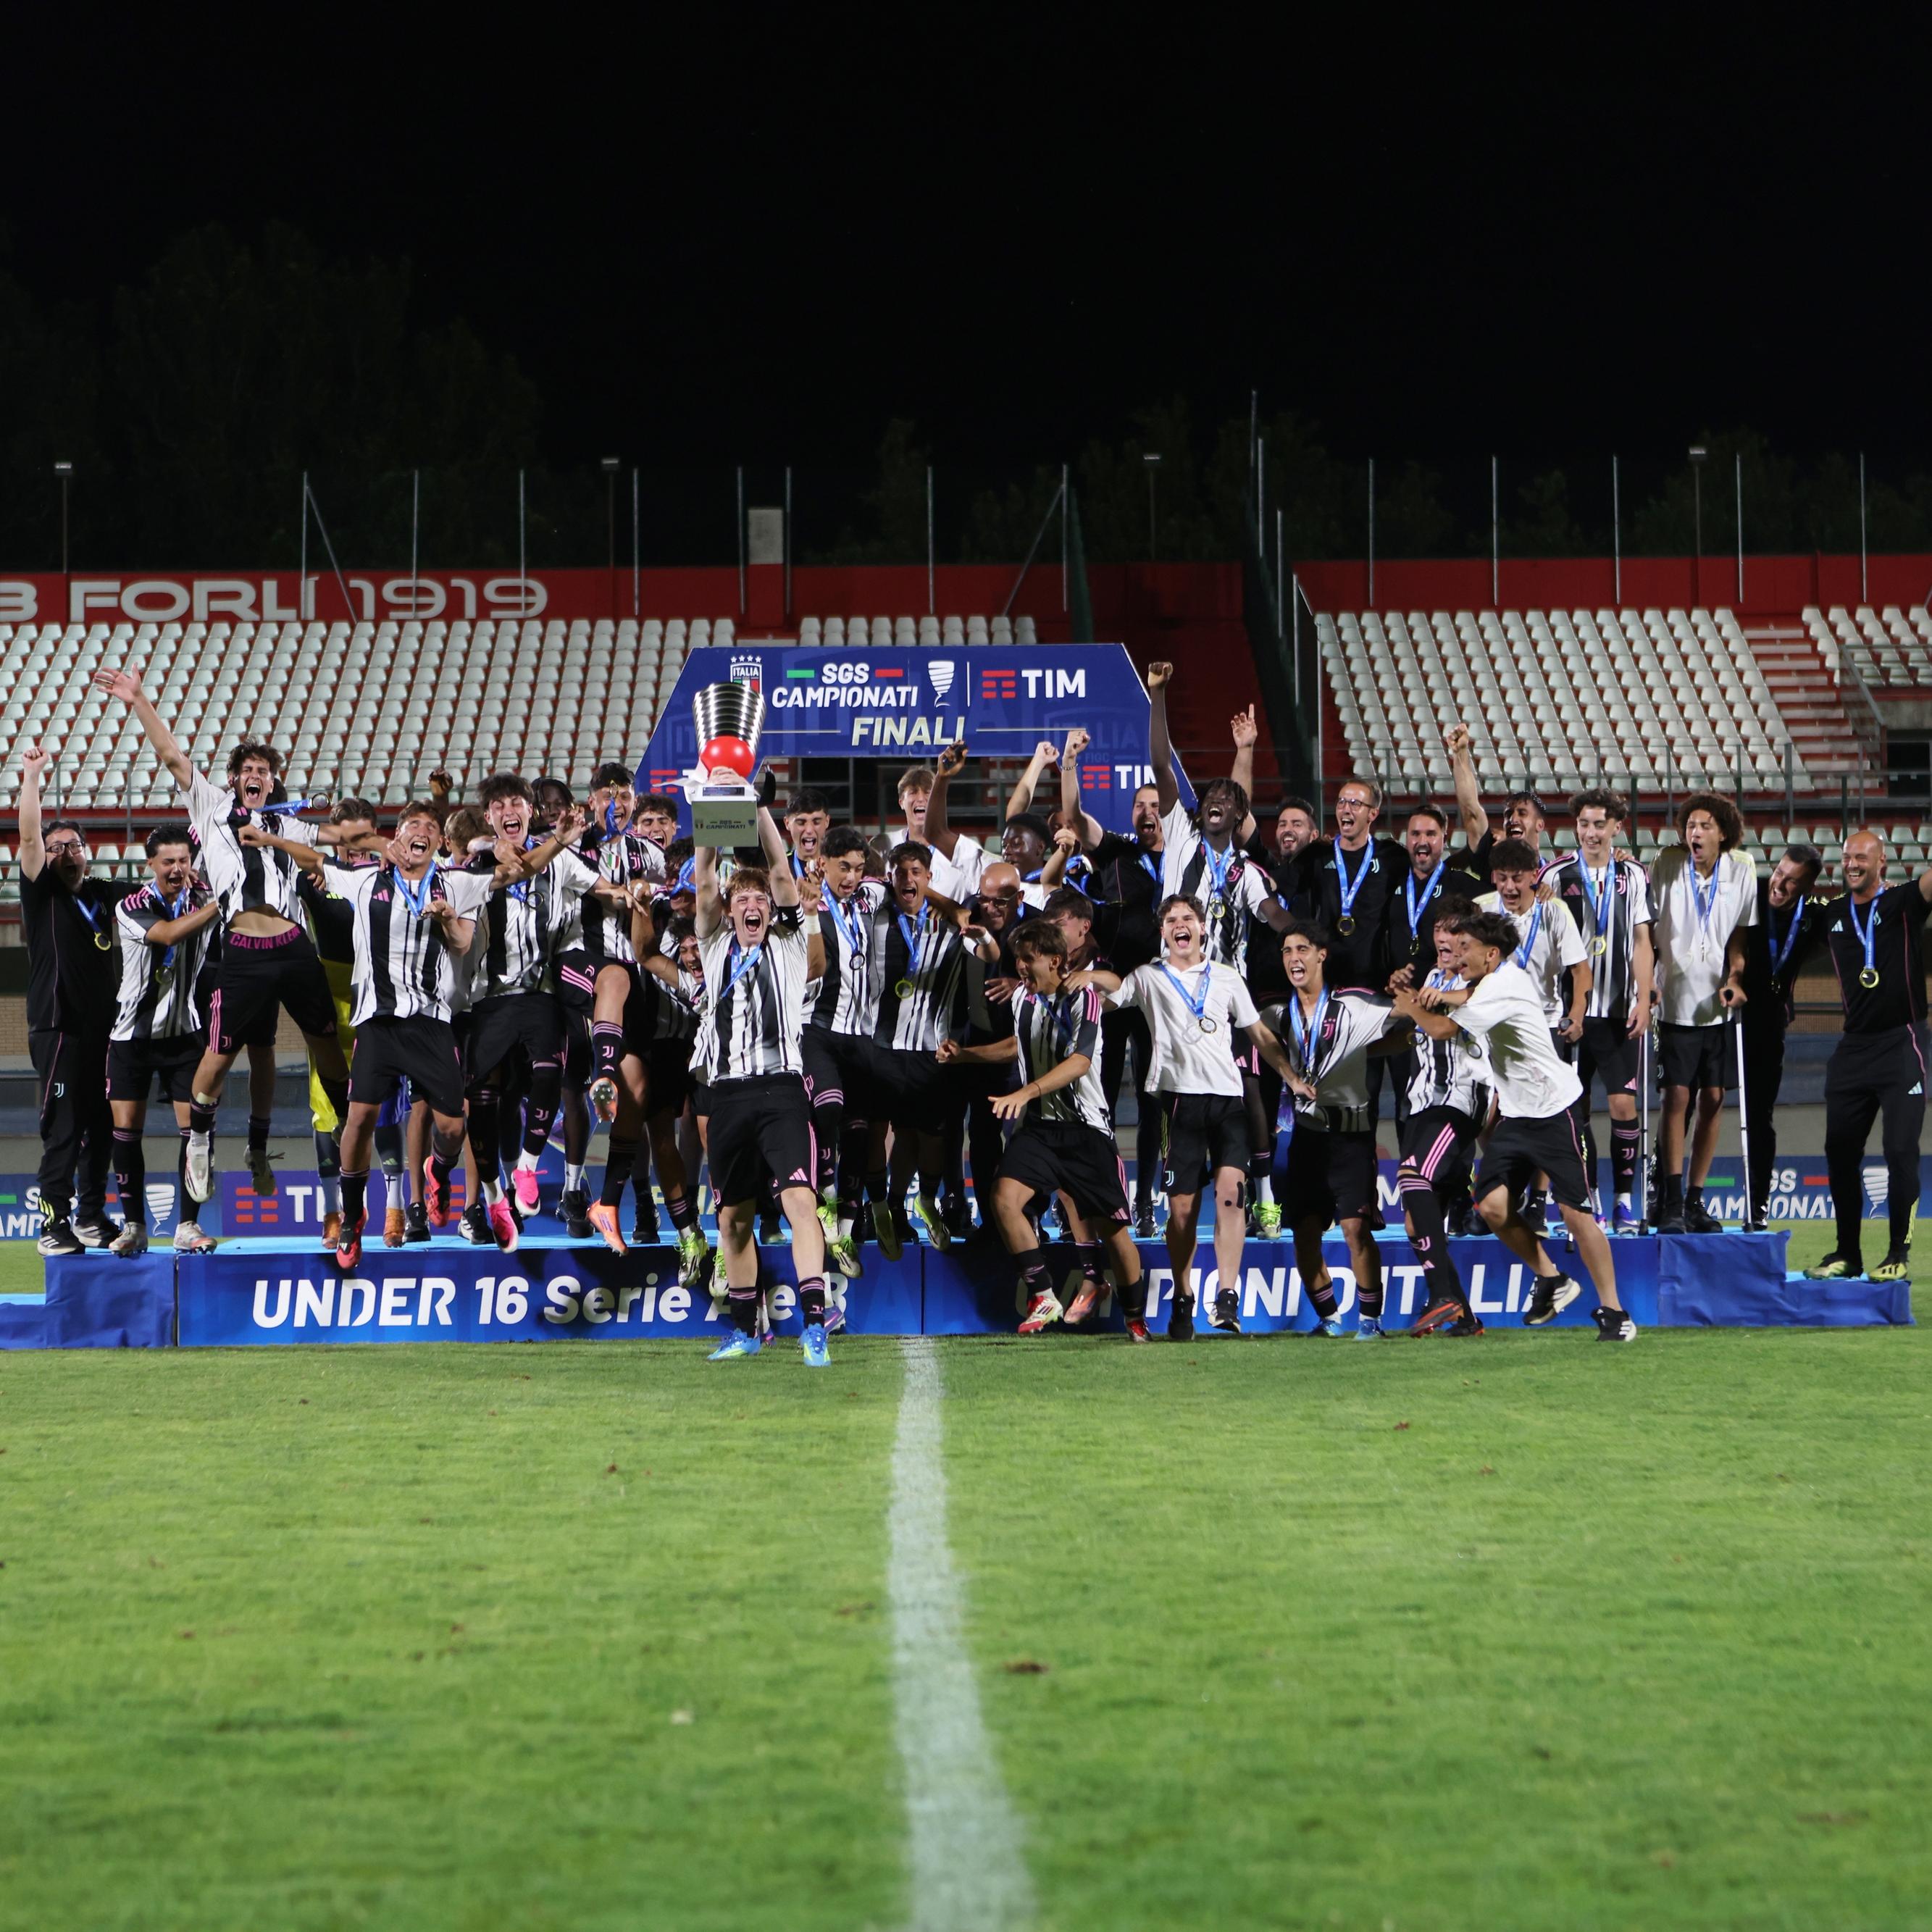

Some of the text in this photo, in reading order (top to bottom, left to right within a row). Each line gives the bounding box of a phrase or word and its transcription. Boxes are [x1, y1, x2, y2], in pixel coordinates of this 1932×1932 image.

[348, 579, 548, 621] 1919
[732, 666, 759, 677] ITALIA
[821, 662, 870, 685] SGS
[1021, 669, 1086, 698] TIM
[771, 685, 919, 708] CAMPIONATI
[851, 716, 965, 746] FINALI
[230, 926, 301, 950] CALVIN KLEIN
[251, 1276, 456, 1328] UNDER
[474, 1276, 529, 1325] 16
[544, 1273, 692, 1324] Serie
